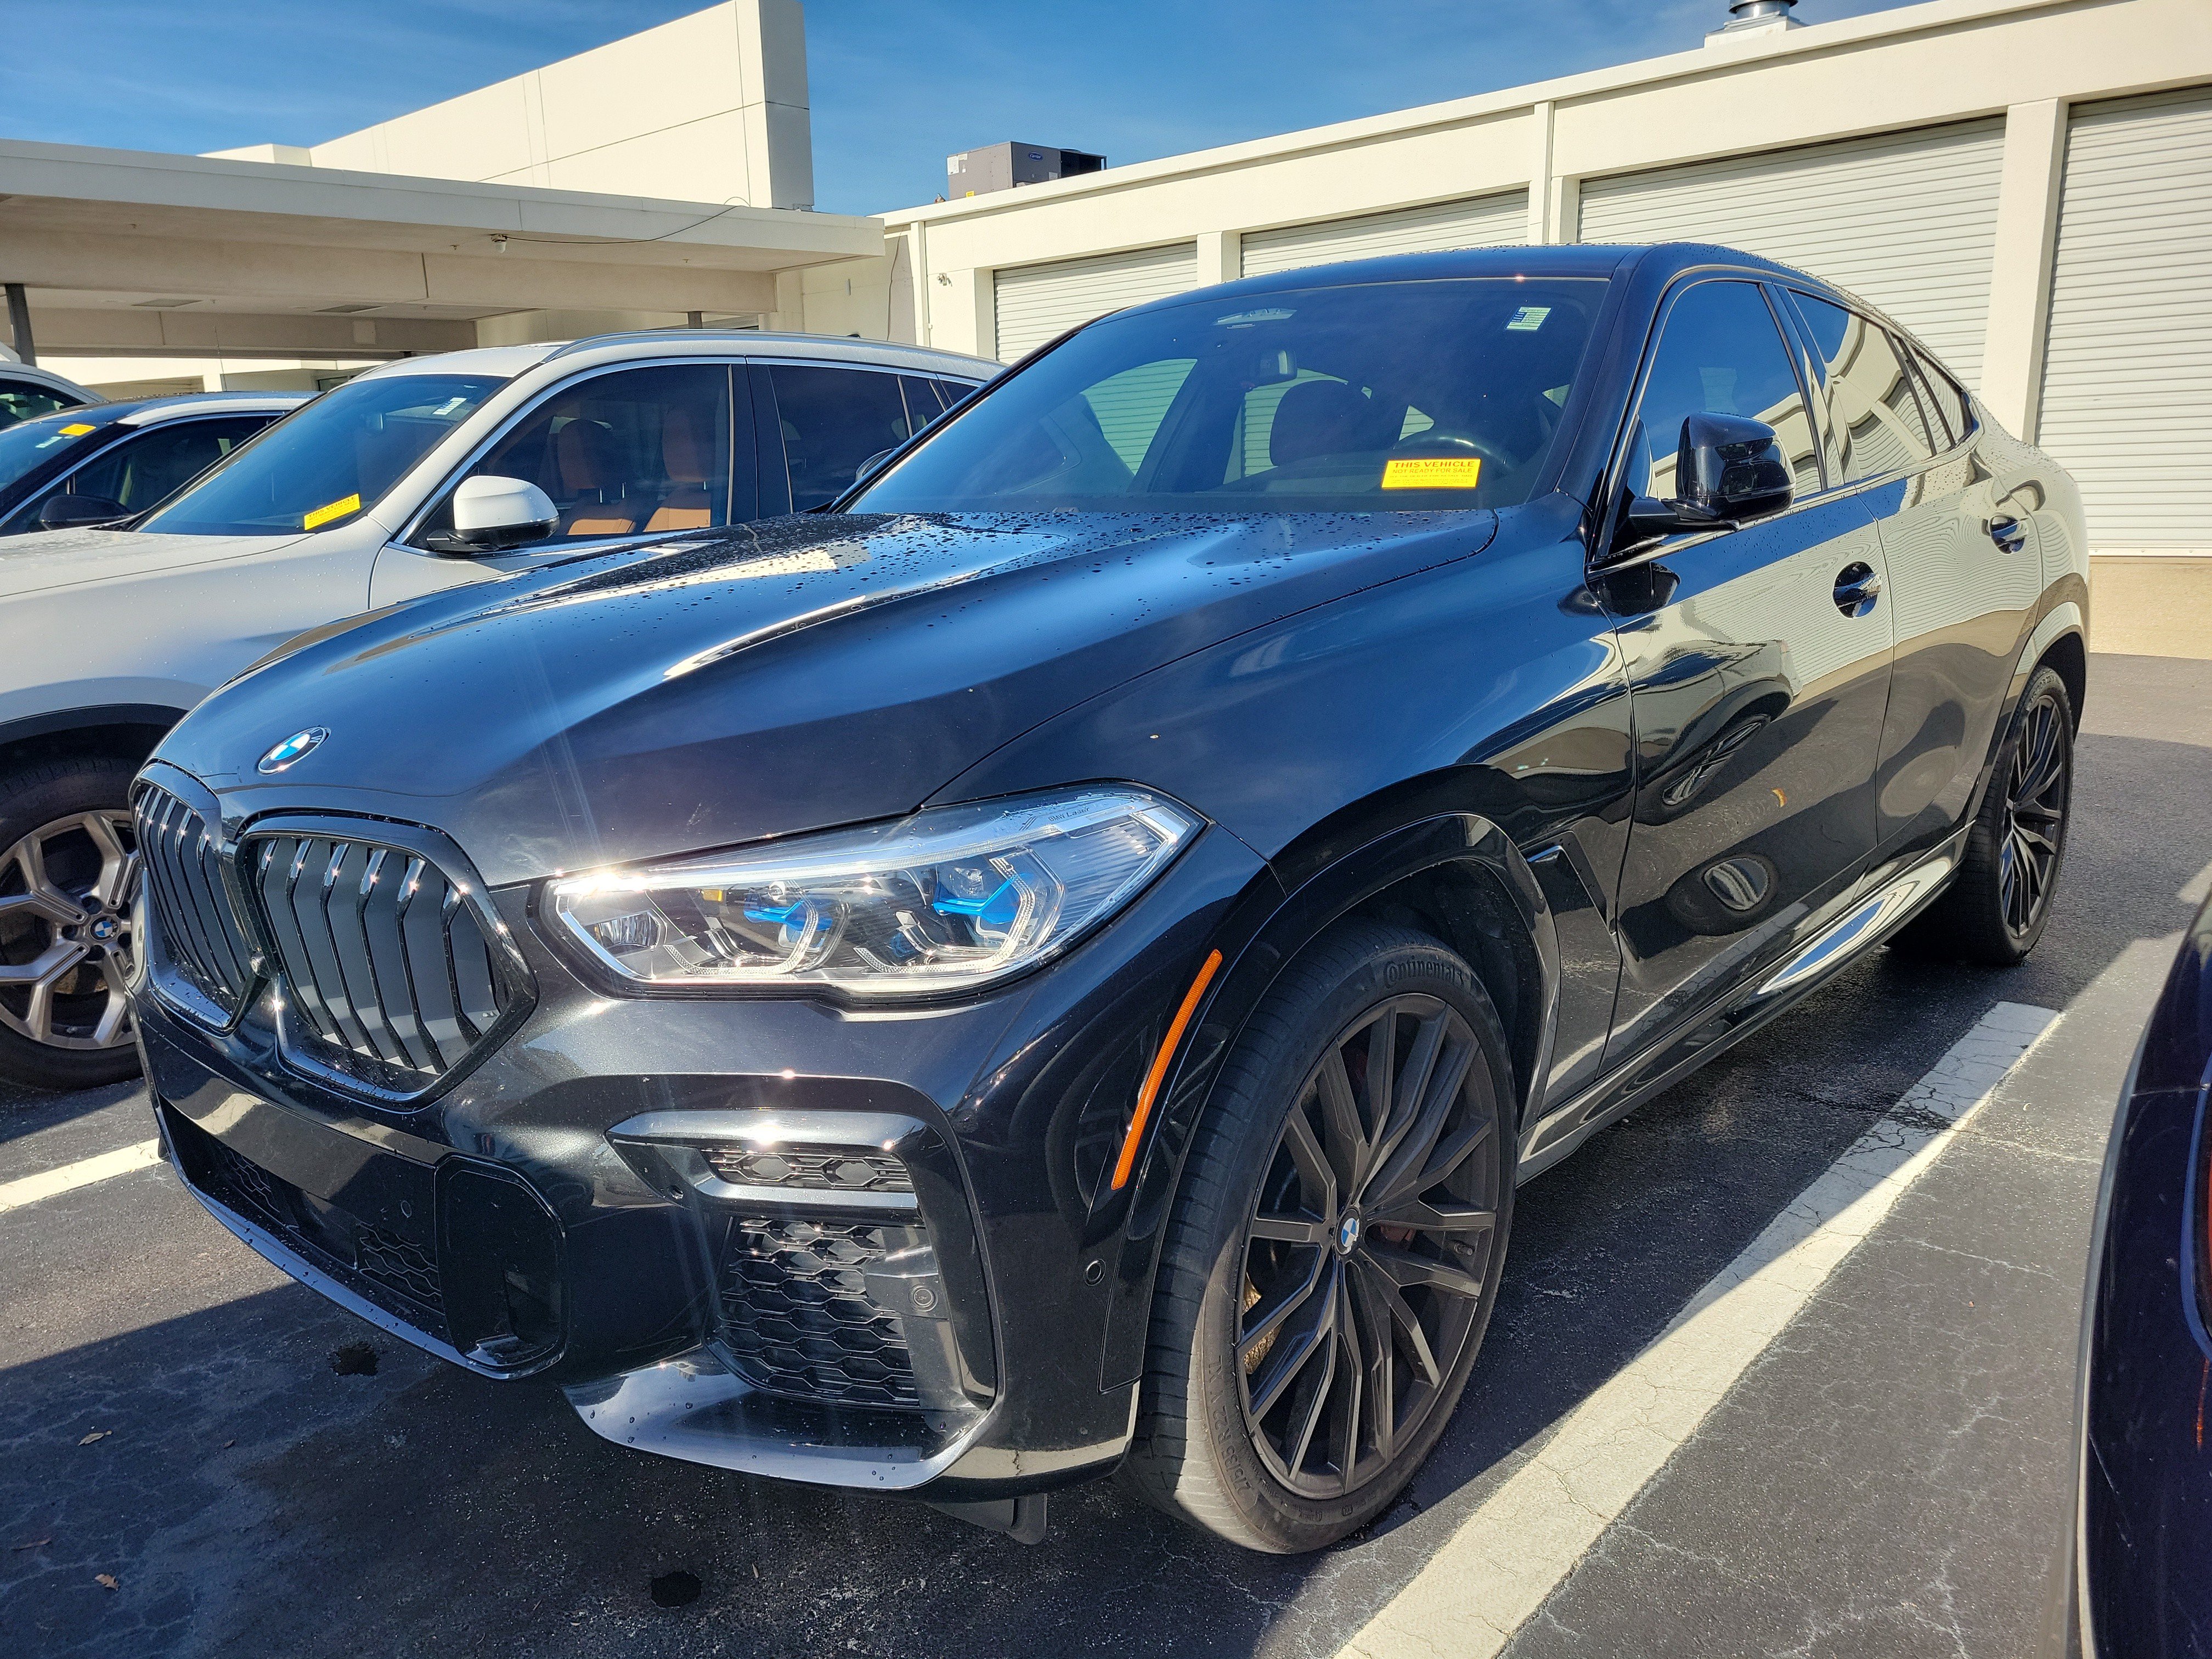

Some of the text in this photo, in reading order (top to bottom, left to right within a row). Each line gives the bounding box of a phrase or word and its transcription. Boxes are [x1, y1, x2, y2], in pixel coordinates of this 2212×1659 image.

[1066, 806, 1090, 817] Laser
[1383, 955, 1455, 989] Continental
[1209, 1355, 1222, 1384] XL
[1221, 1445, 1251, 1496] 275/35
